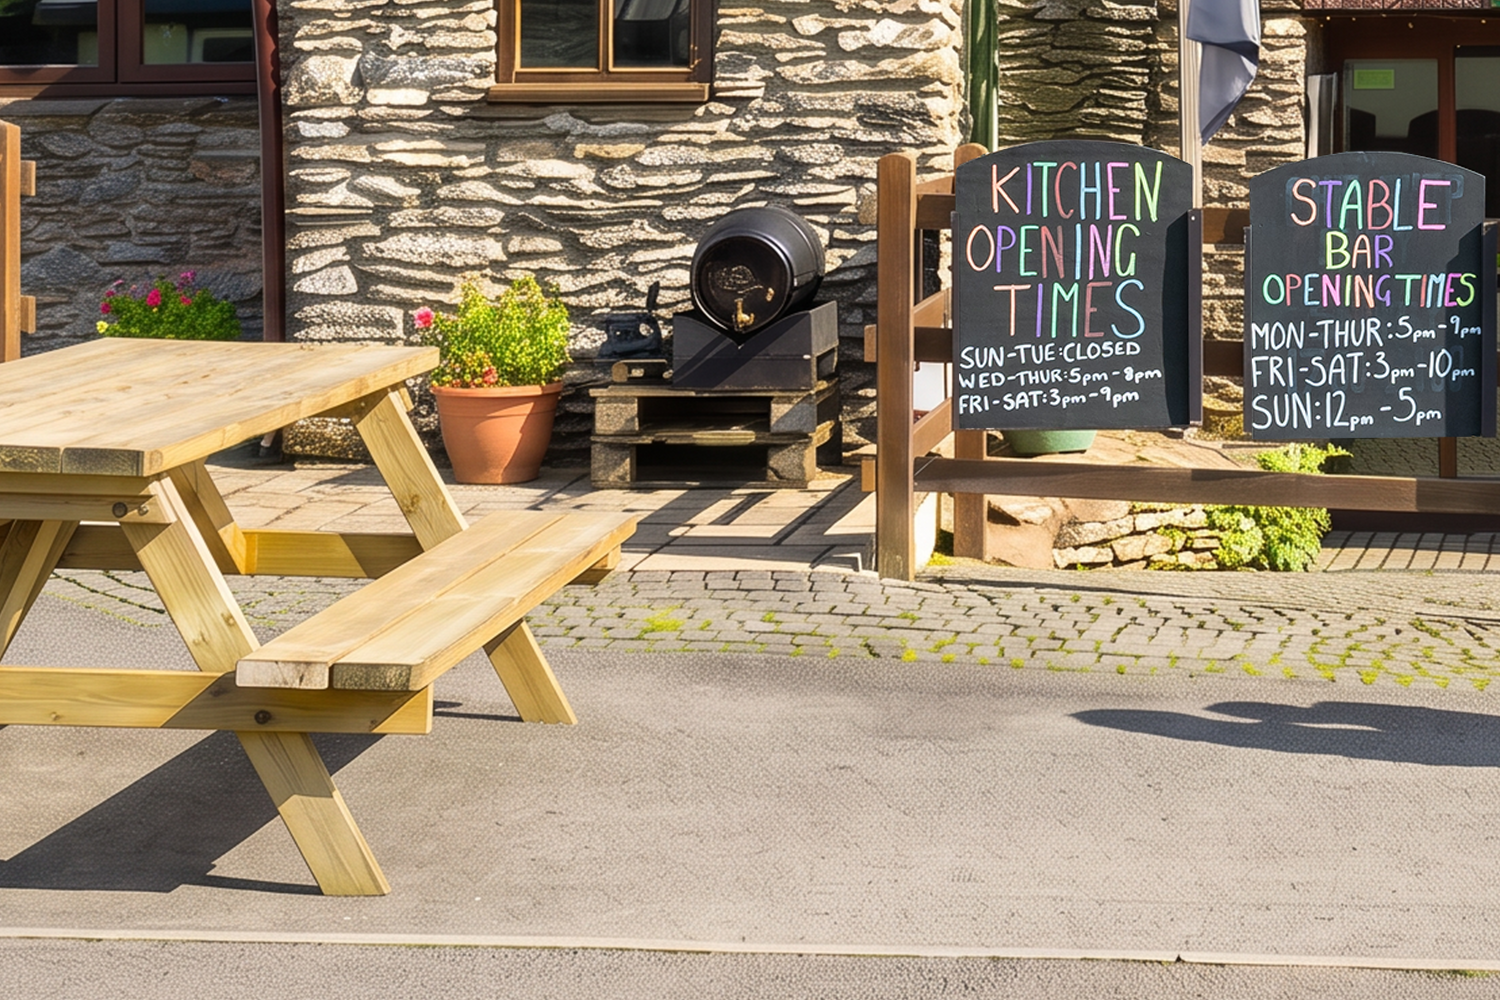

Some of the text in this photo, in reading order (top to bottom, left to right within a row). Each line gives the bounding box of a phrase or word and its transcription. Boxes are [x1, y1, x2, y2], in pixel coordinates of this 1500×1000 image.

[991, 160, 1163, 222] KITCHEN
[1290, 178, 1451, 231] STABLE
[966, 223, 1141, 280] OPENING
[1325, 230, 1394, 270] BAR
[993, 278, 1146, 339] TIMES
[1262, 272, 1477, 308] OPENING TIMES
